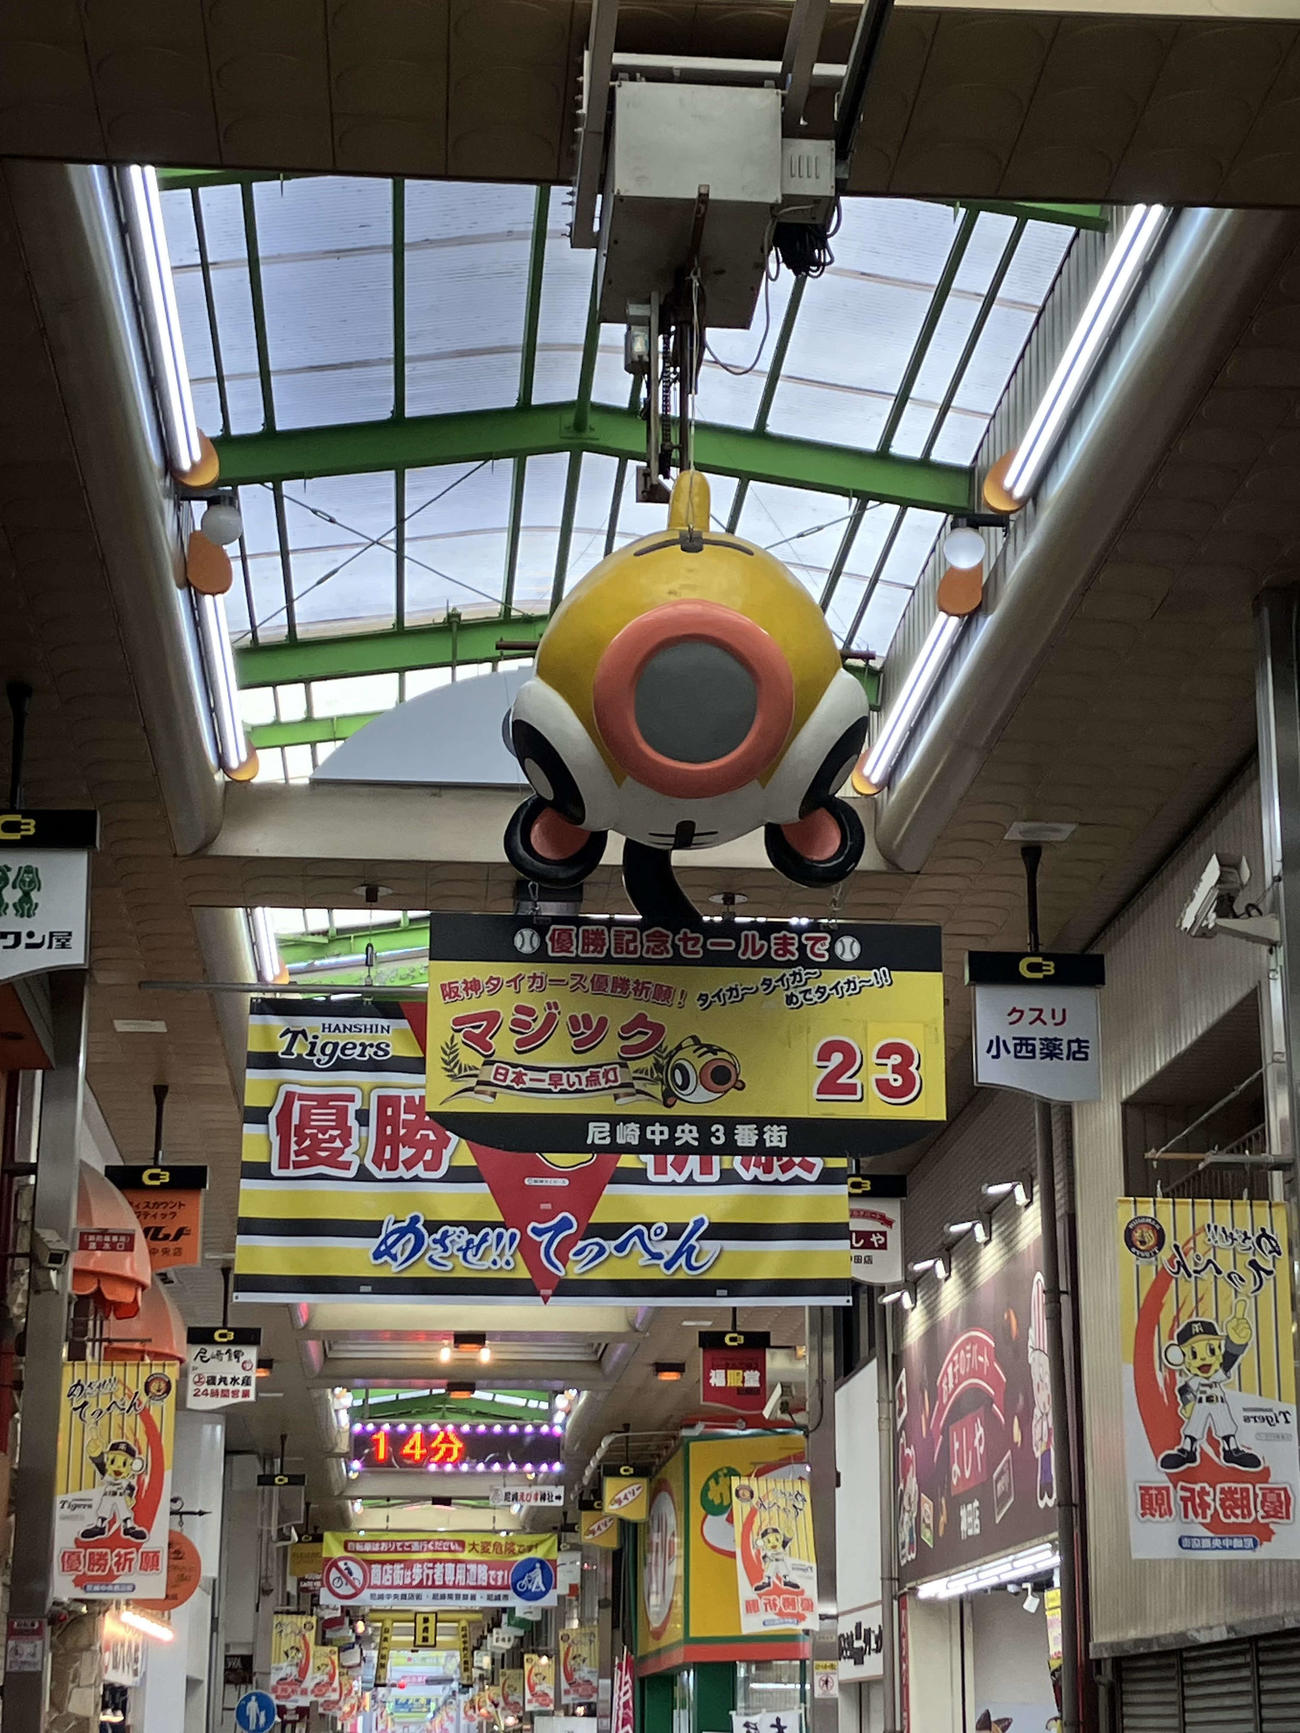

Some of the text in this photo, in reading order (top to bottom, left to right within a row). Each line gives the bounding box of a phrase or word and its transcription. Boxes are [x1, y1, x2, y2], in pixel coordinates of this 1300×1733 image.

[546, 926, 831, 962] 優勝記念セールまで
[321, 1022, 391, 1036] HANSHIN
[450, 1001, 667, 1061] マジック
[1007, 1006, 1068, 1027] クスリ
[278, 1027, 391, 1068] Tigers
[986, 1035, 1090, 1062] 小西薬店
[491, 1063, 620, 1090] 日本一早い点灯
[814, 1036, 922, 1106] 23
[272, 1086, 456, 1177] 優勝
[528, 1212, 722, 1276] てっぺん
[850, 1255, 873, 1265] 田店
[951, 1416, 986, 1487] よしや
[61, 1550, 161, 1574] 優勝祈願
